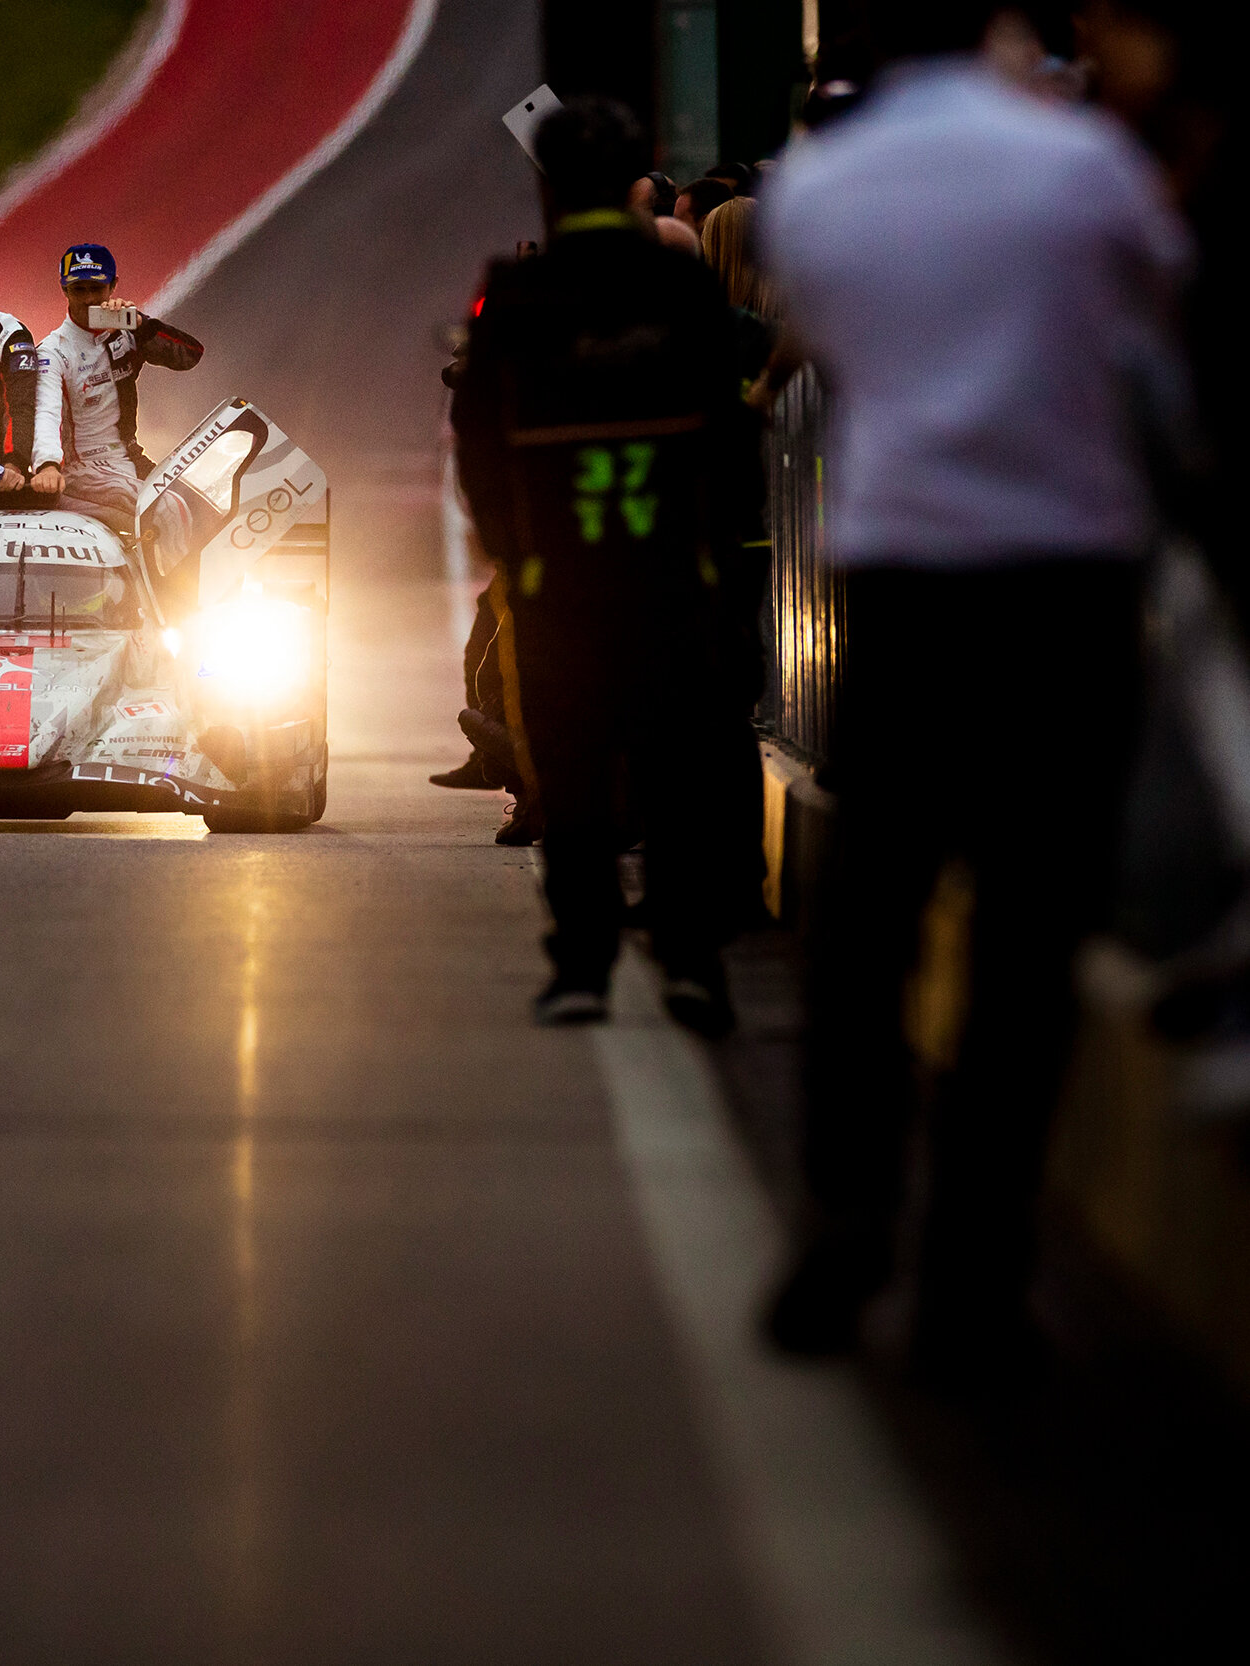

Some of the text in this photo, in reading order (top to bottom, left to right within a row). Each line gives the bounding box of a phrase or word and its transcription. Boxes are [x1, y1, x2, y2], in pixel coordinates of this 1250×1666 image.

[70, 264, 102, 272] MICHELIN
[152, 420, 227, 495] Matmut
[230, 477, 314, 550] COOL
[124, 703, 164, 717] P1
[109, 736, 183, 744] NORTHWIRE
